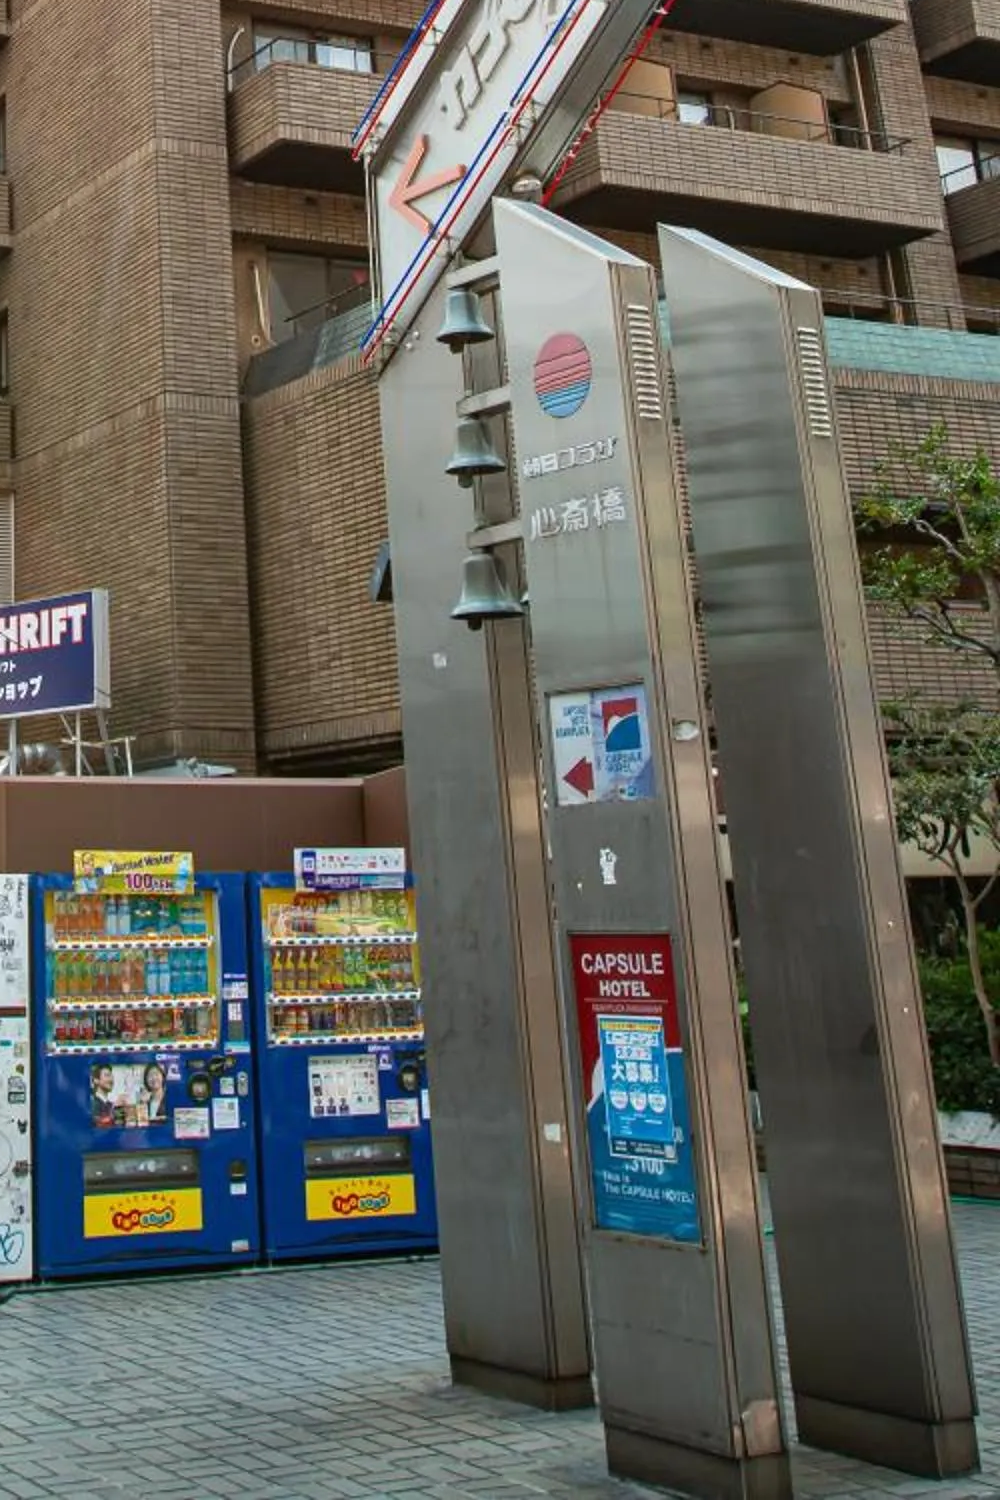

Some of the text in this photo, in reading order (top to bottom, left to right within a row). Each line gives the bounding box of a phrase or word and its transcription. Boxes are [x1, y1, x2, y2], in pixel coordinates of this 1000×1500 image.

[530, 485, 627, 542] 心斎橋
[580, 952, 665, 975] CAPSULE
[599, 979, 651, 997] HOTEL
